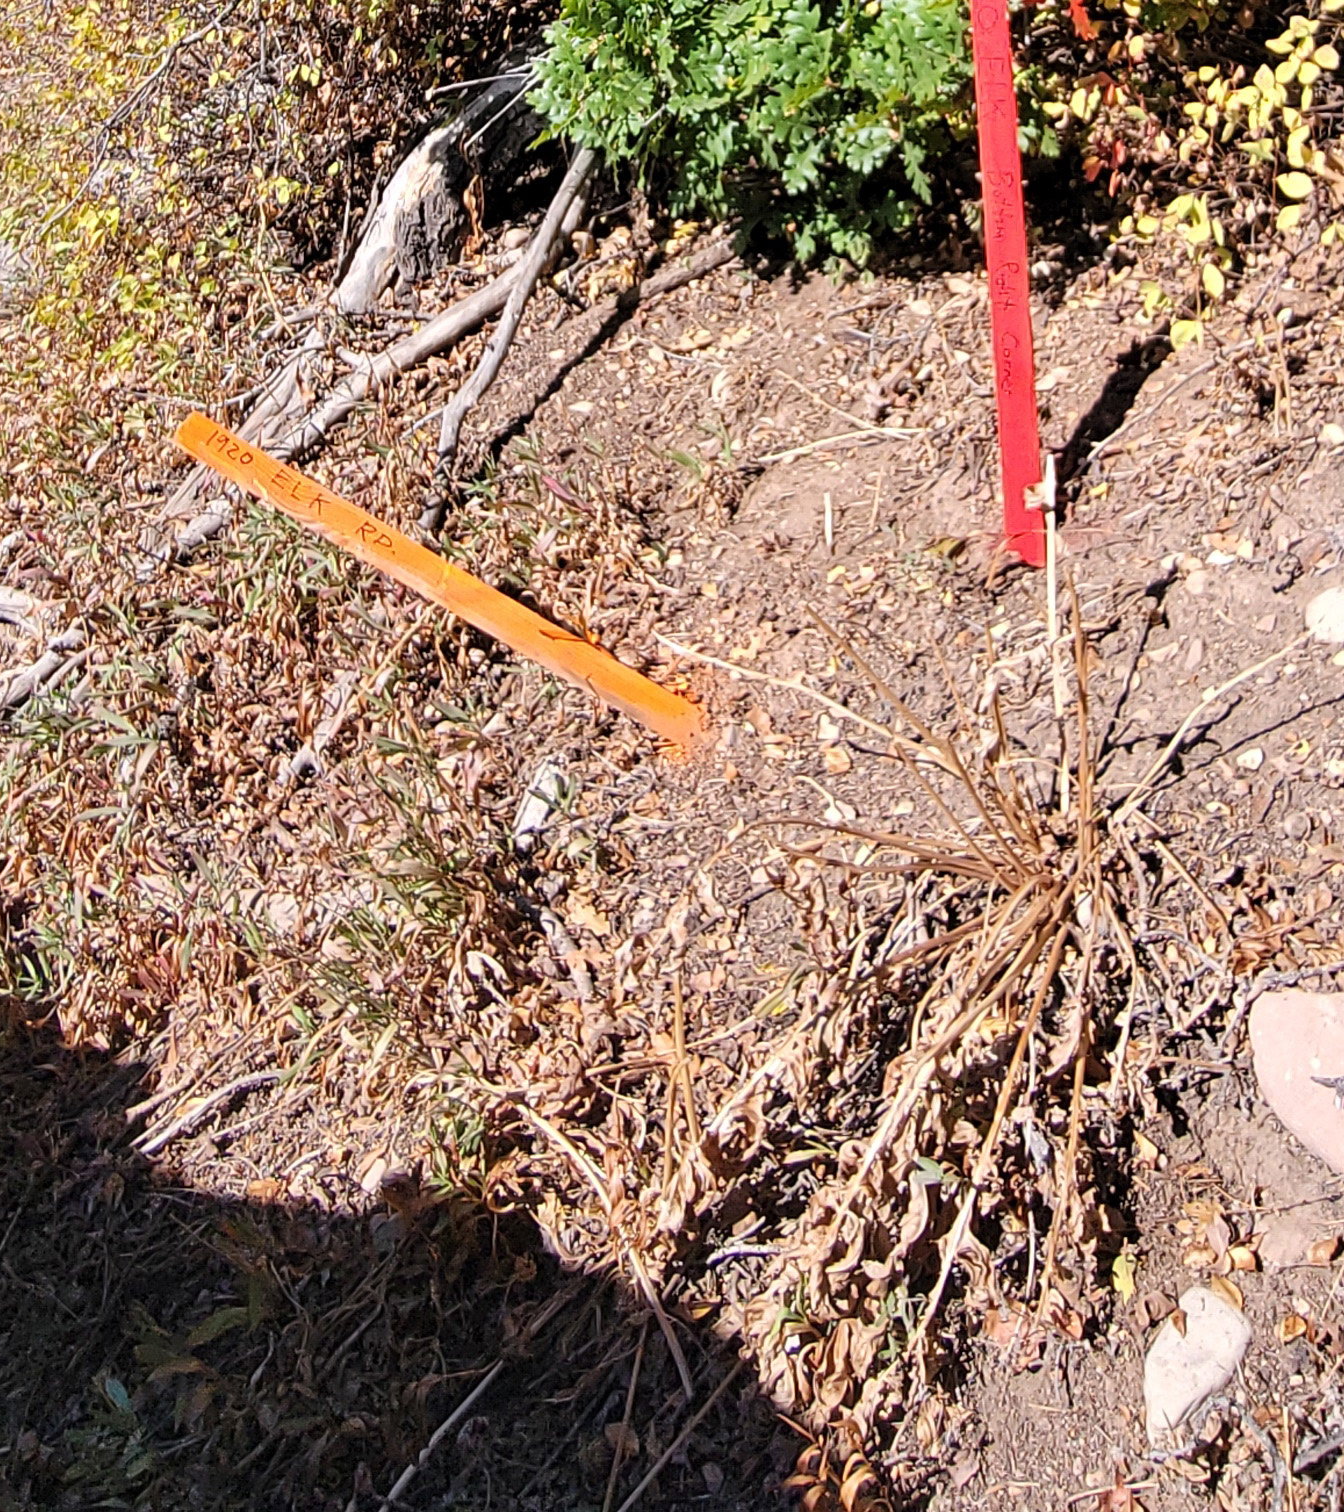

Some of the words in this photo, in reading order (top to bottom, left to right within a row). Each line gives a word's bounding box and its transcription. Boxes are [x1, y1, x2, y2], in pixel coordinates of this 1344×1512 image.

[978, 56, 1008, 119] ELK
[1001, 331, 1019, 397] Corner
[205, 429, 254, 465] 1920
[271, 468, 332, 516] ELK
[355, 520, 396, 555] RD.
